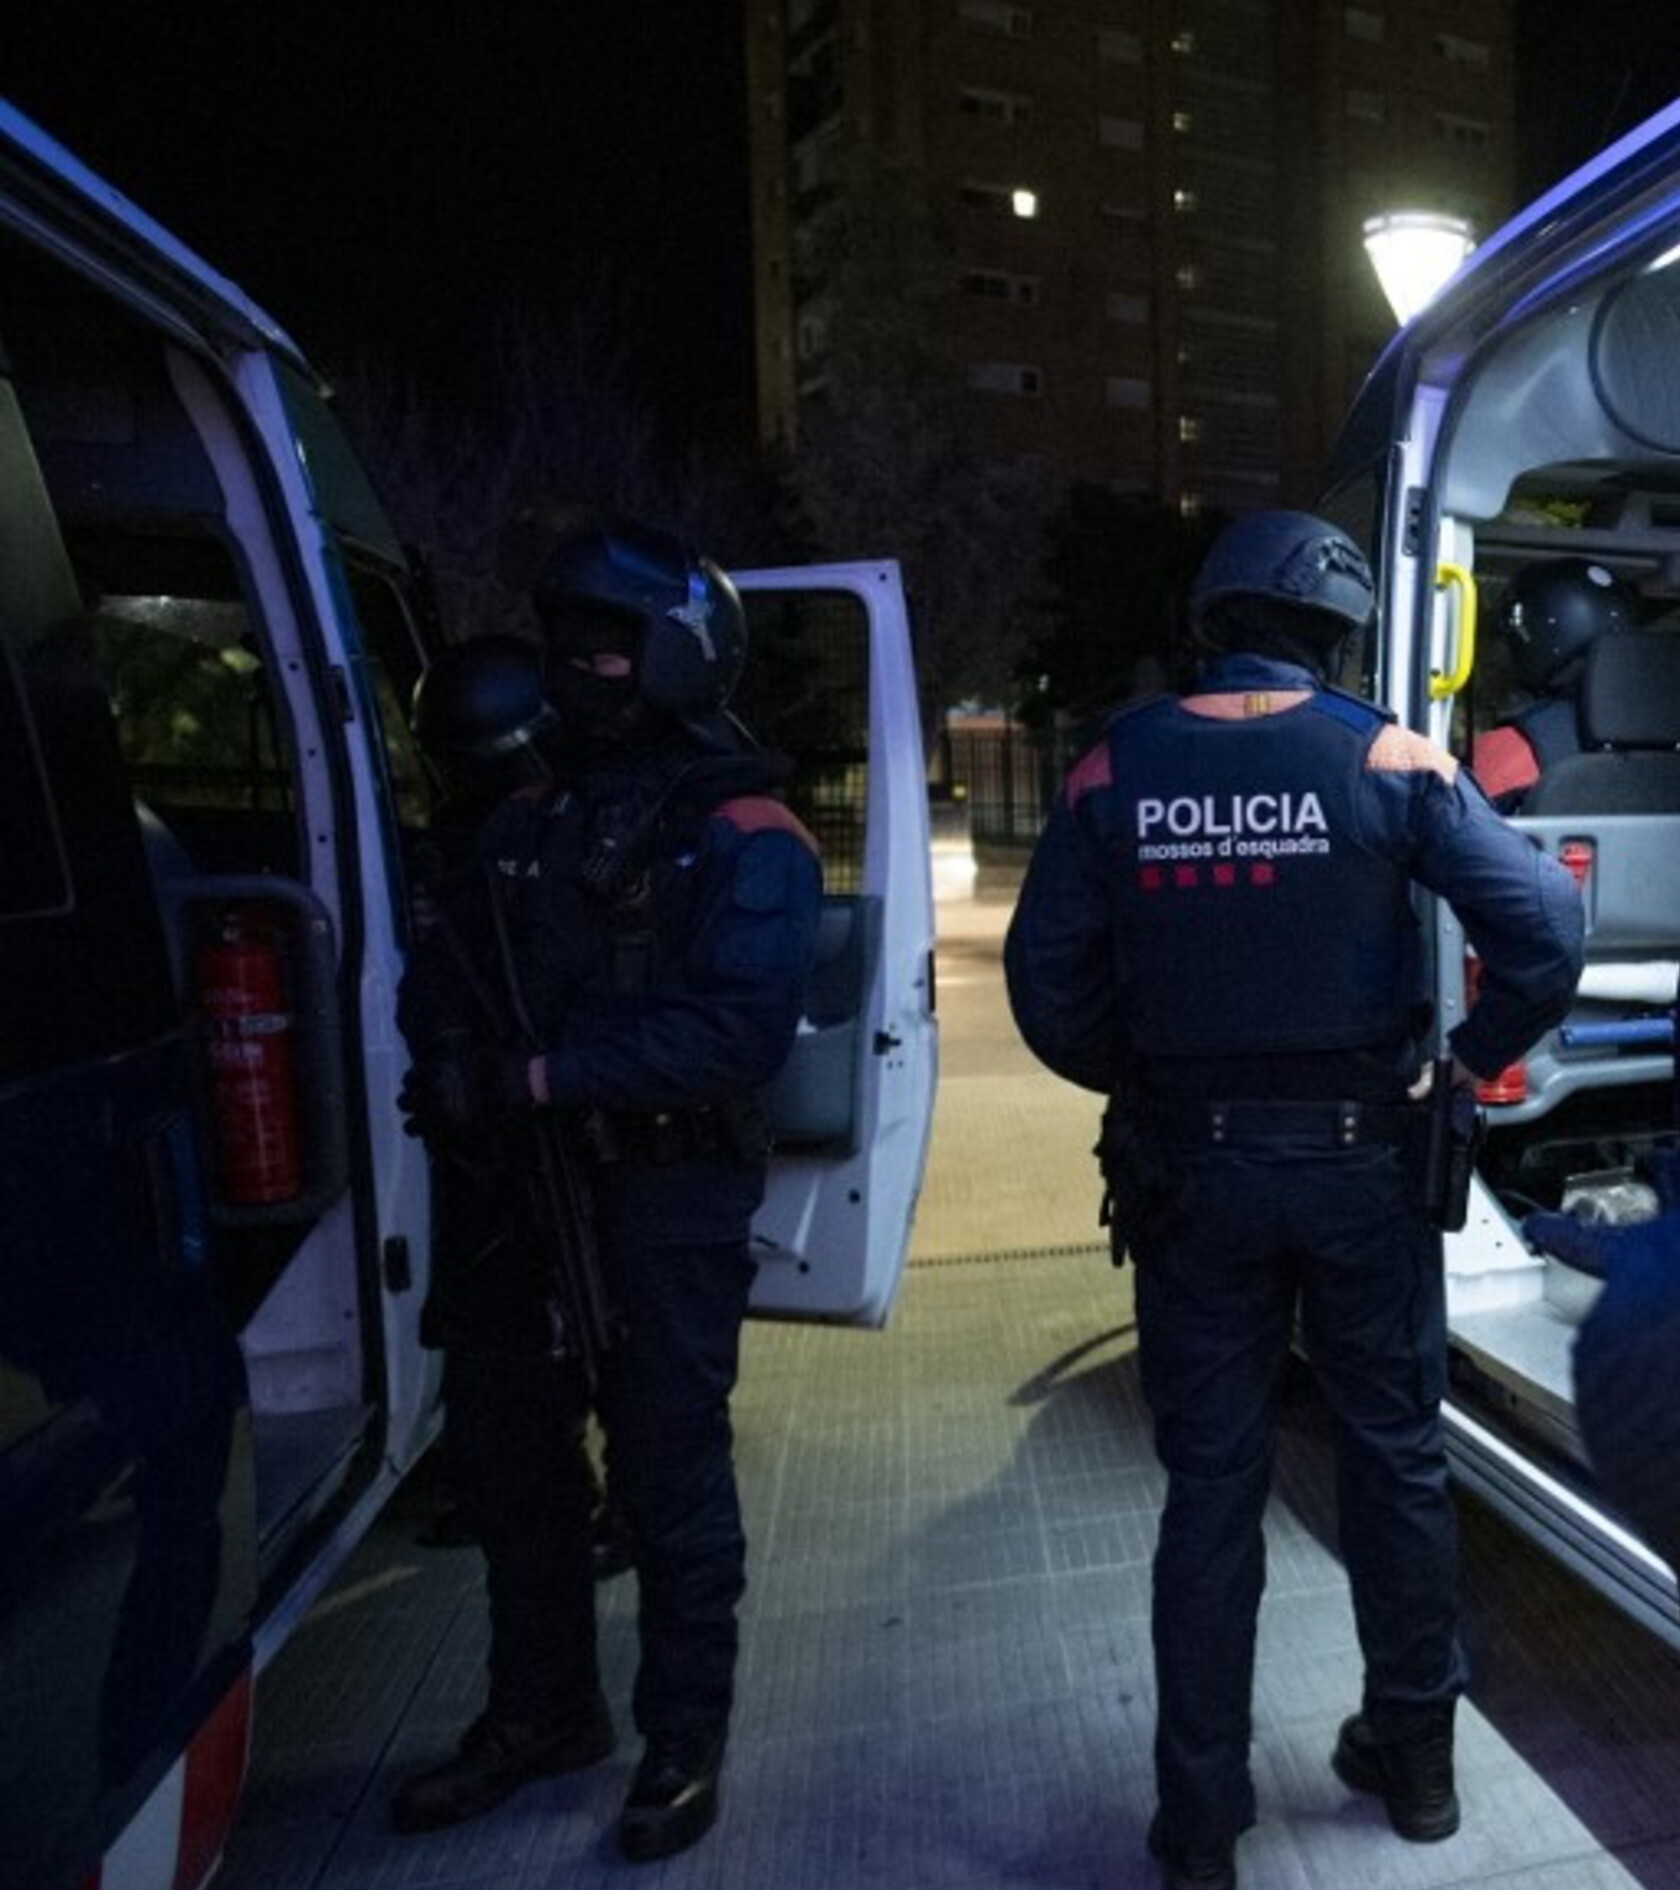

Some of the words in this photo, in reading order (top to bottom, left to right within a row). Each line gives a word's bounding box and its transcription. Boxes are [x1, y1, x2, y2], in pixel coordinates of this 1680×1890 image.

[1137, 792, 1328, 838] POLICIA
[1138, 840, 1213, 860] mossos
[1217, 835, 1331, 859] d'esquadra
